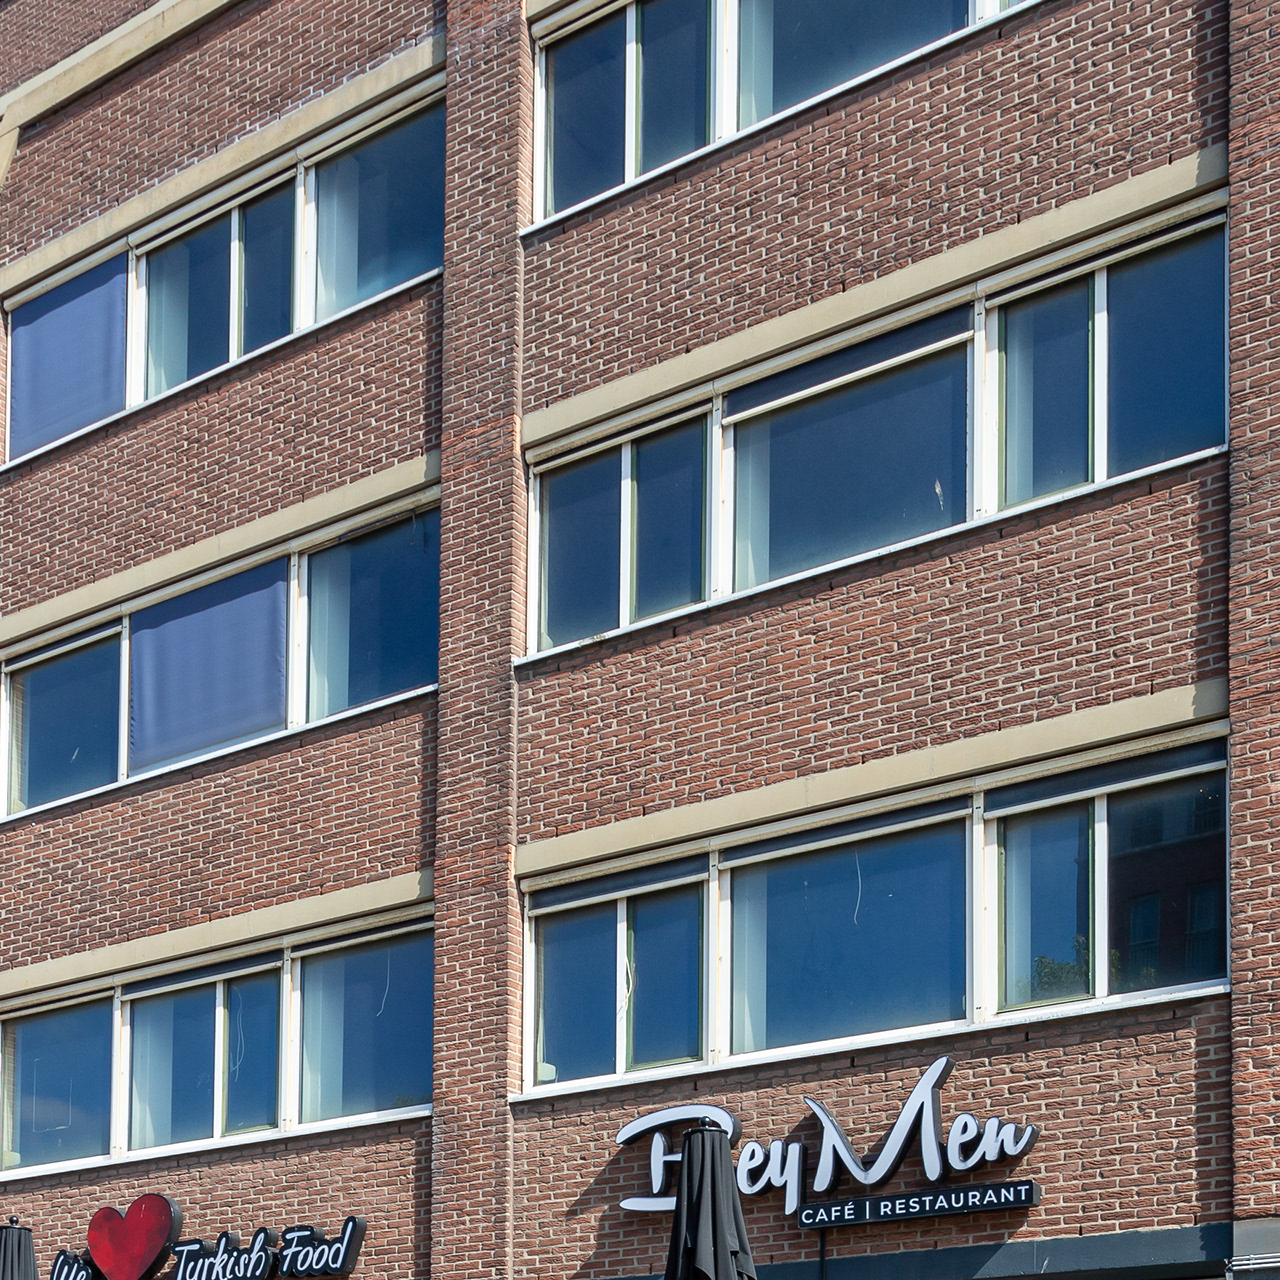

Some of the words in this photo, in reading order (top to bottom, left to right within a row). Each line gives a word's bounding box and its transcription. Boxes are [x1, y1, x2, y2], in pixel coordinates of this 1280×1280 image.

[801, 1202, 855, 1225] CAFÉ
[880, 1185, 1030, 1216] RESTAURANT
[282, 1221, 354, 1273] Food
